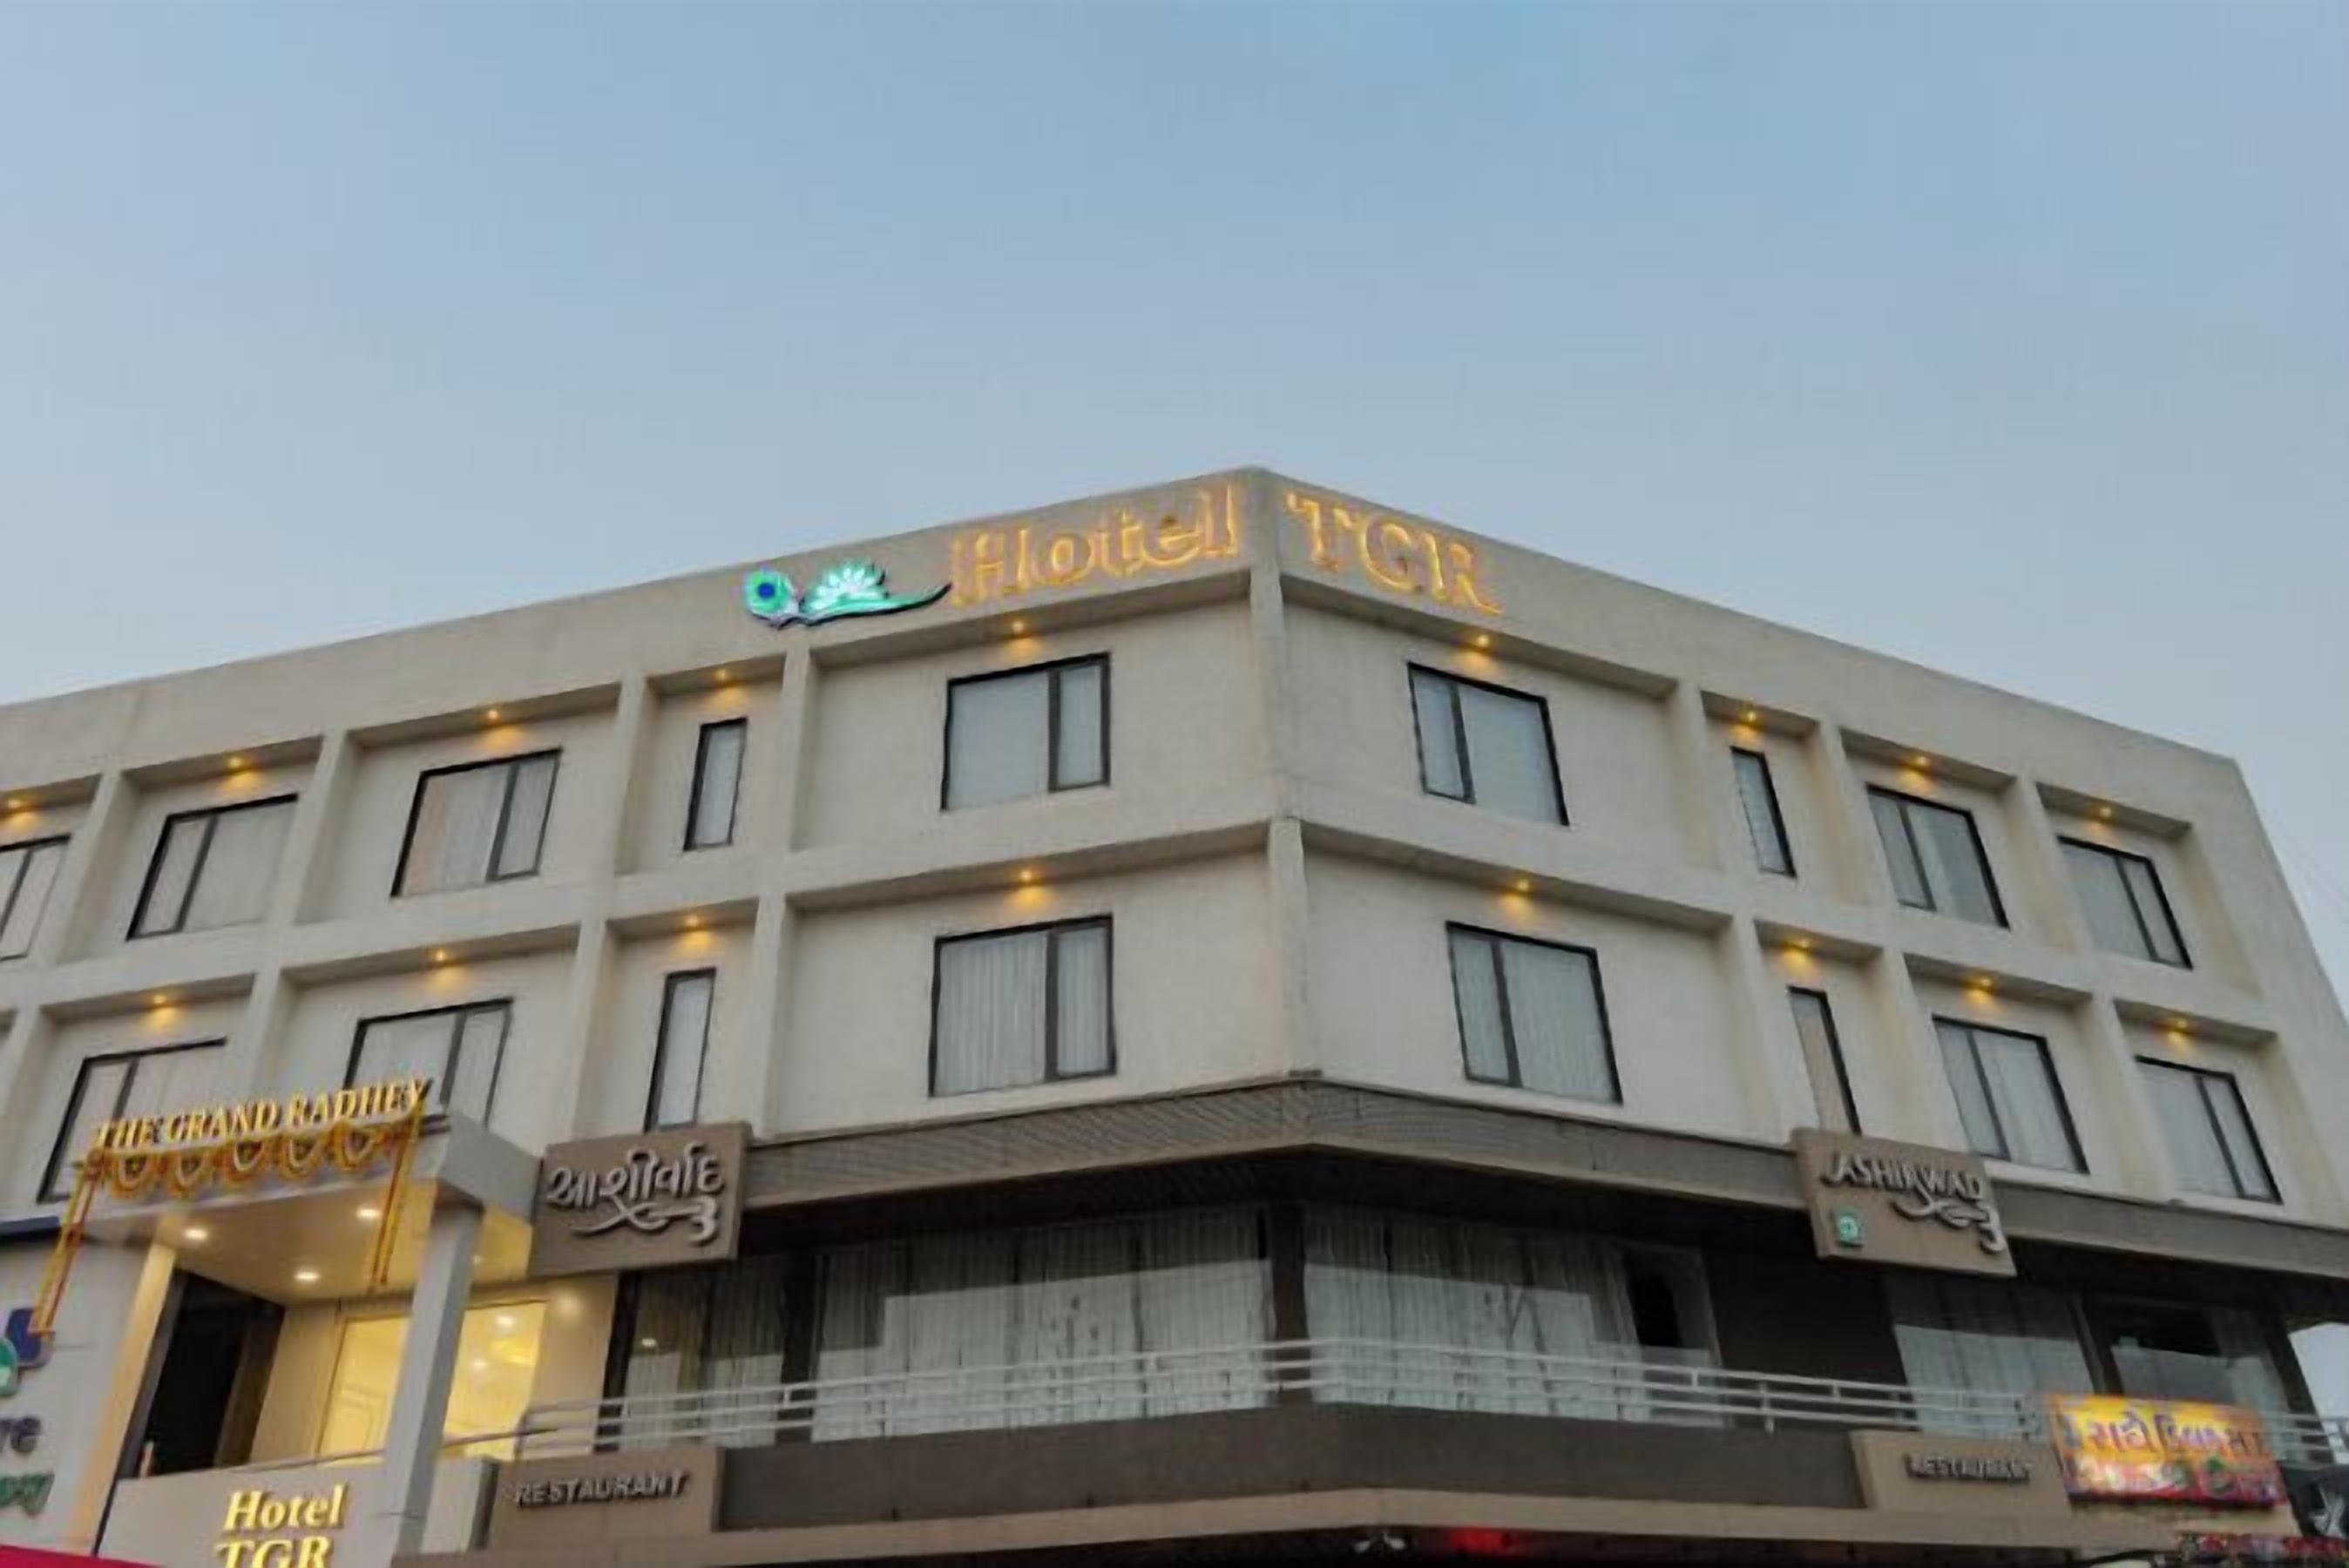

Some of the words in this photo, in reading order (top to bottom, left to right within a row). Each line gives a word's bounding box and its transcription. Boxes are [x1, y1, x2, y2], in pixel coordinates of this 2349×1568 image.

[951, 482, 1238, 607] Hotel
[96, 1116, 163, 1149] THE
[166, 1099, 279, 1143] GRAND
[286, 1077, 429, 1130] RADHEY
[223, 1482, 346, 1531] Hotel
[515, 1470, 690, 1507] RESTAURANT
